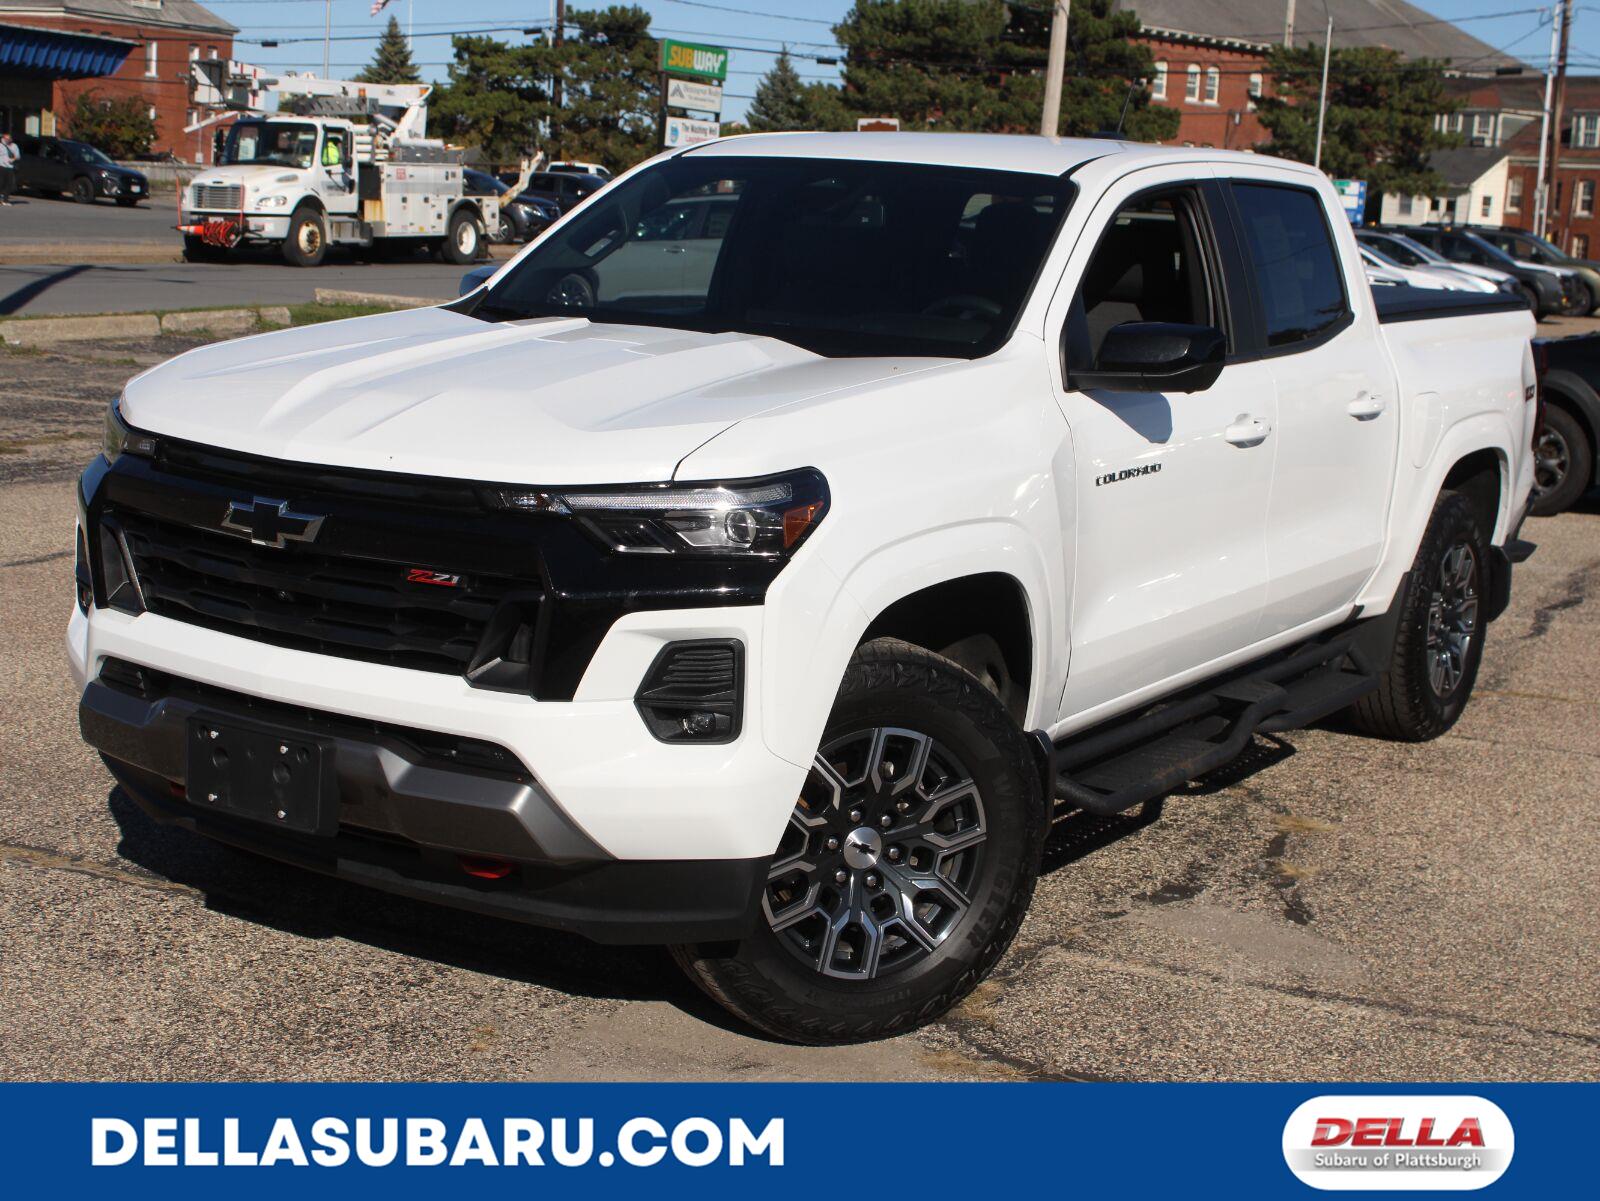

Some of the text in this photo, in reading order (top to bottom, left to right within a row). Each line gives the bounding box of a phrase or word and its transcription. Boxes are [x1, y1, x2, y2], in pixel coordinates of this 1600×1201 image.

[668, 45, 725, 73] SUBWAY
[1095, 463, 1162, 487] COLORADO
[407, 569, 460, 587] Z71
